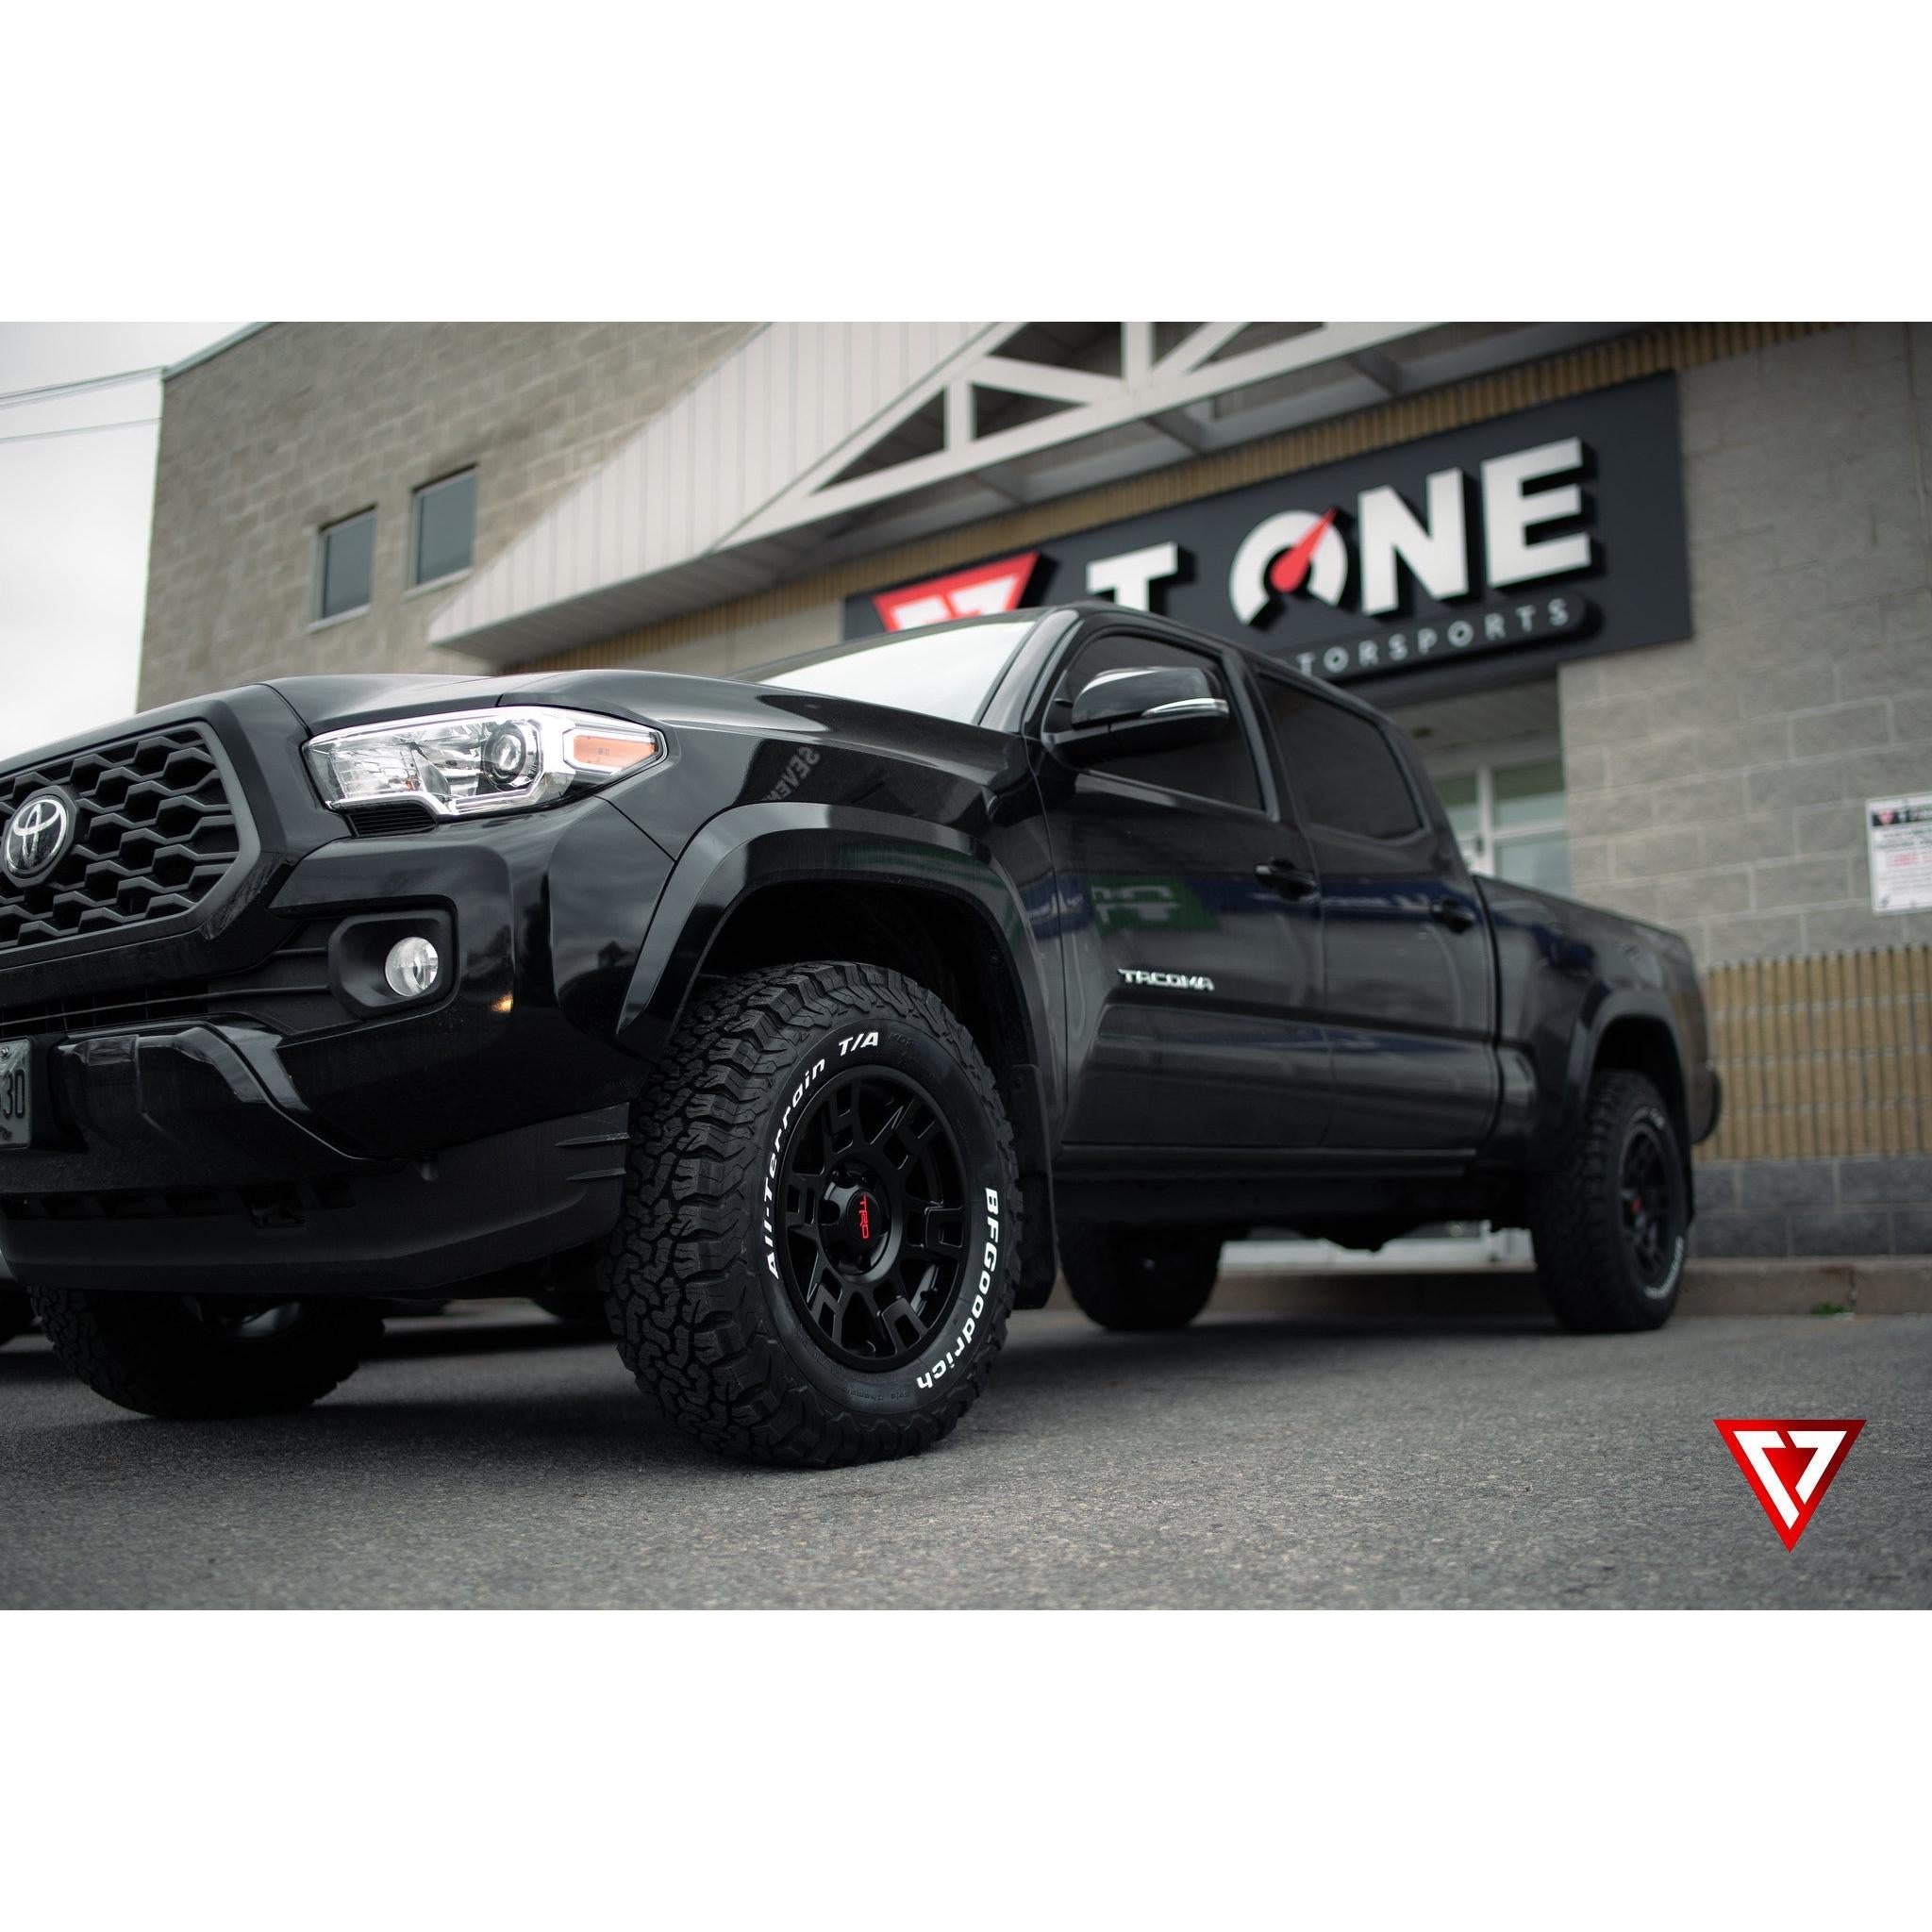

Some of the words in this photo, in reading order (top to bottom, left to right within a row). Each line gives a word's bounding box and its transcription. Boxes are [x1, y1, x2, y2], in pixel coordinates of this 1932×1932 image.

[1229, 437, 1592, 625] ONE
[1295, 596, 1570, 677] TORSPORTS
[1117, 968, 1215, 991] TACOMA
[0, 1069, 25, 1120] 30
[858, 1191, 870, 1240] TRD
[916, 1186, 999, 1390] BFGoodrich
